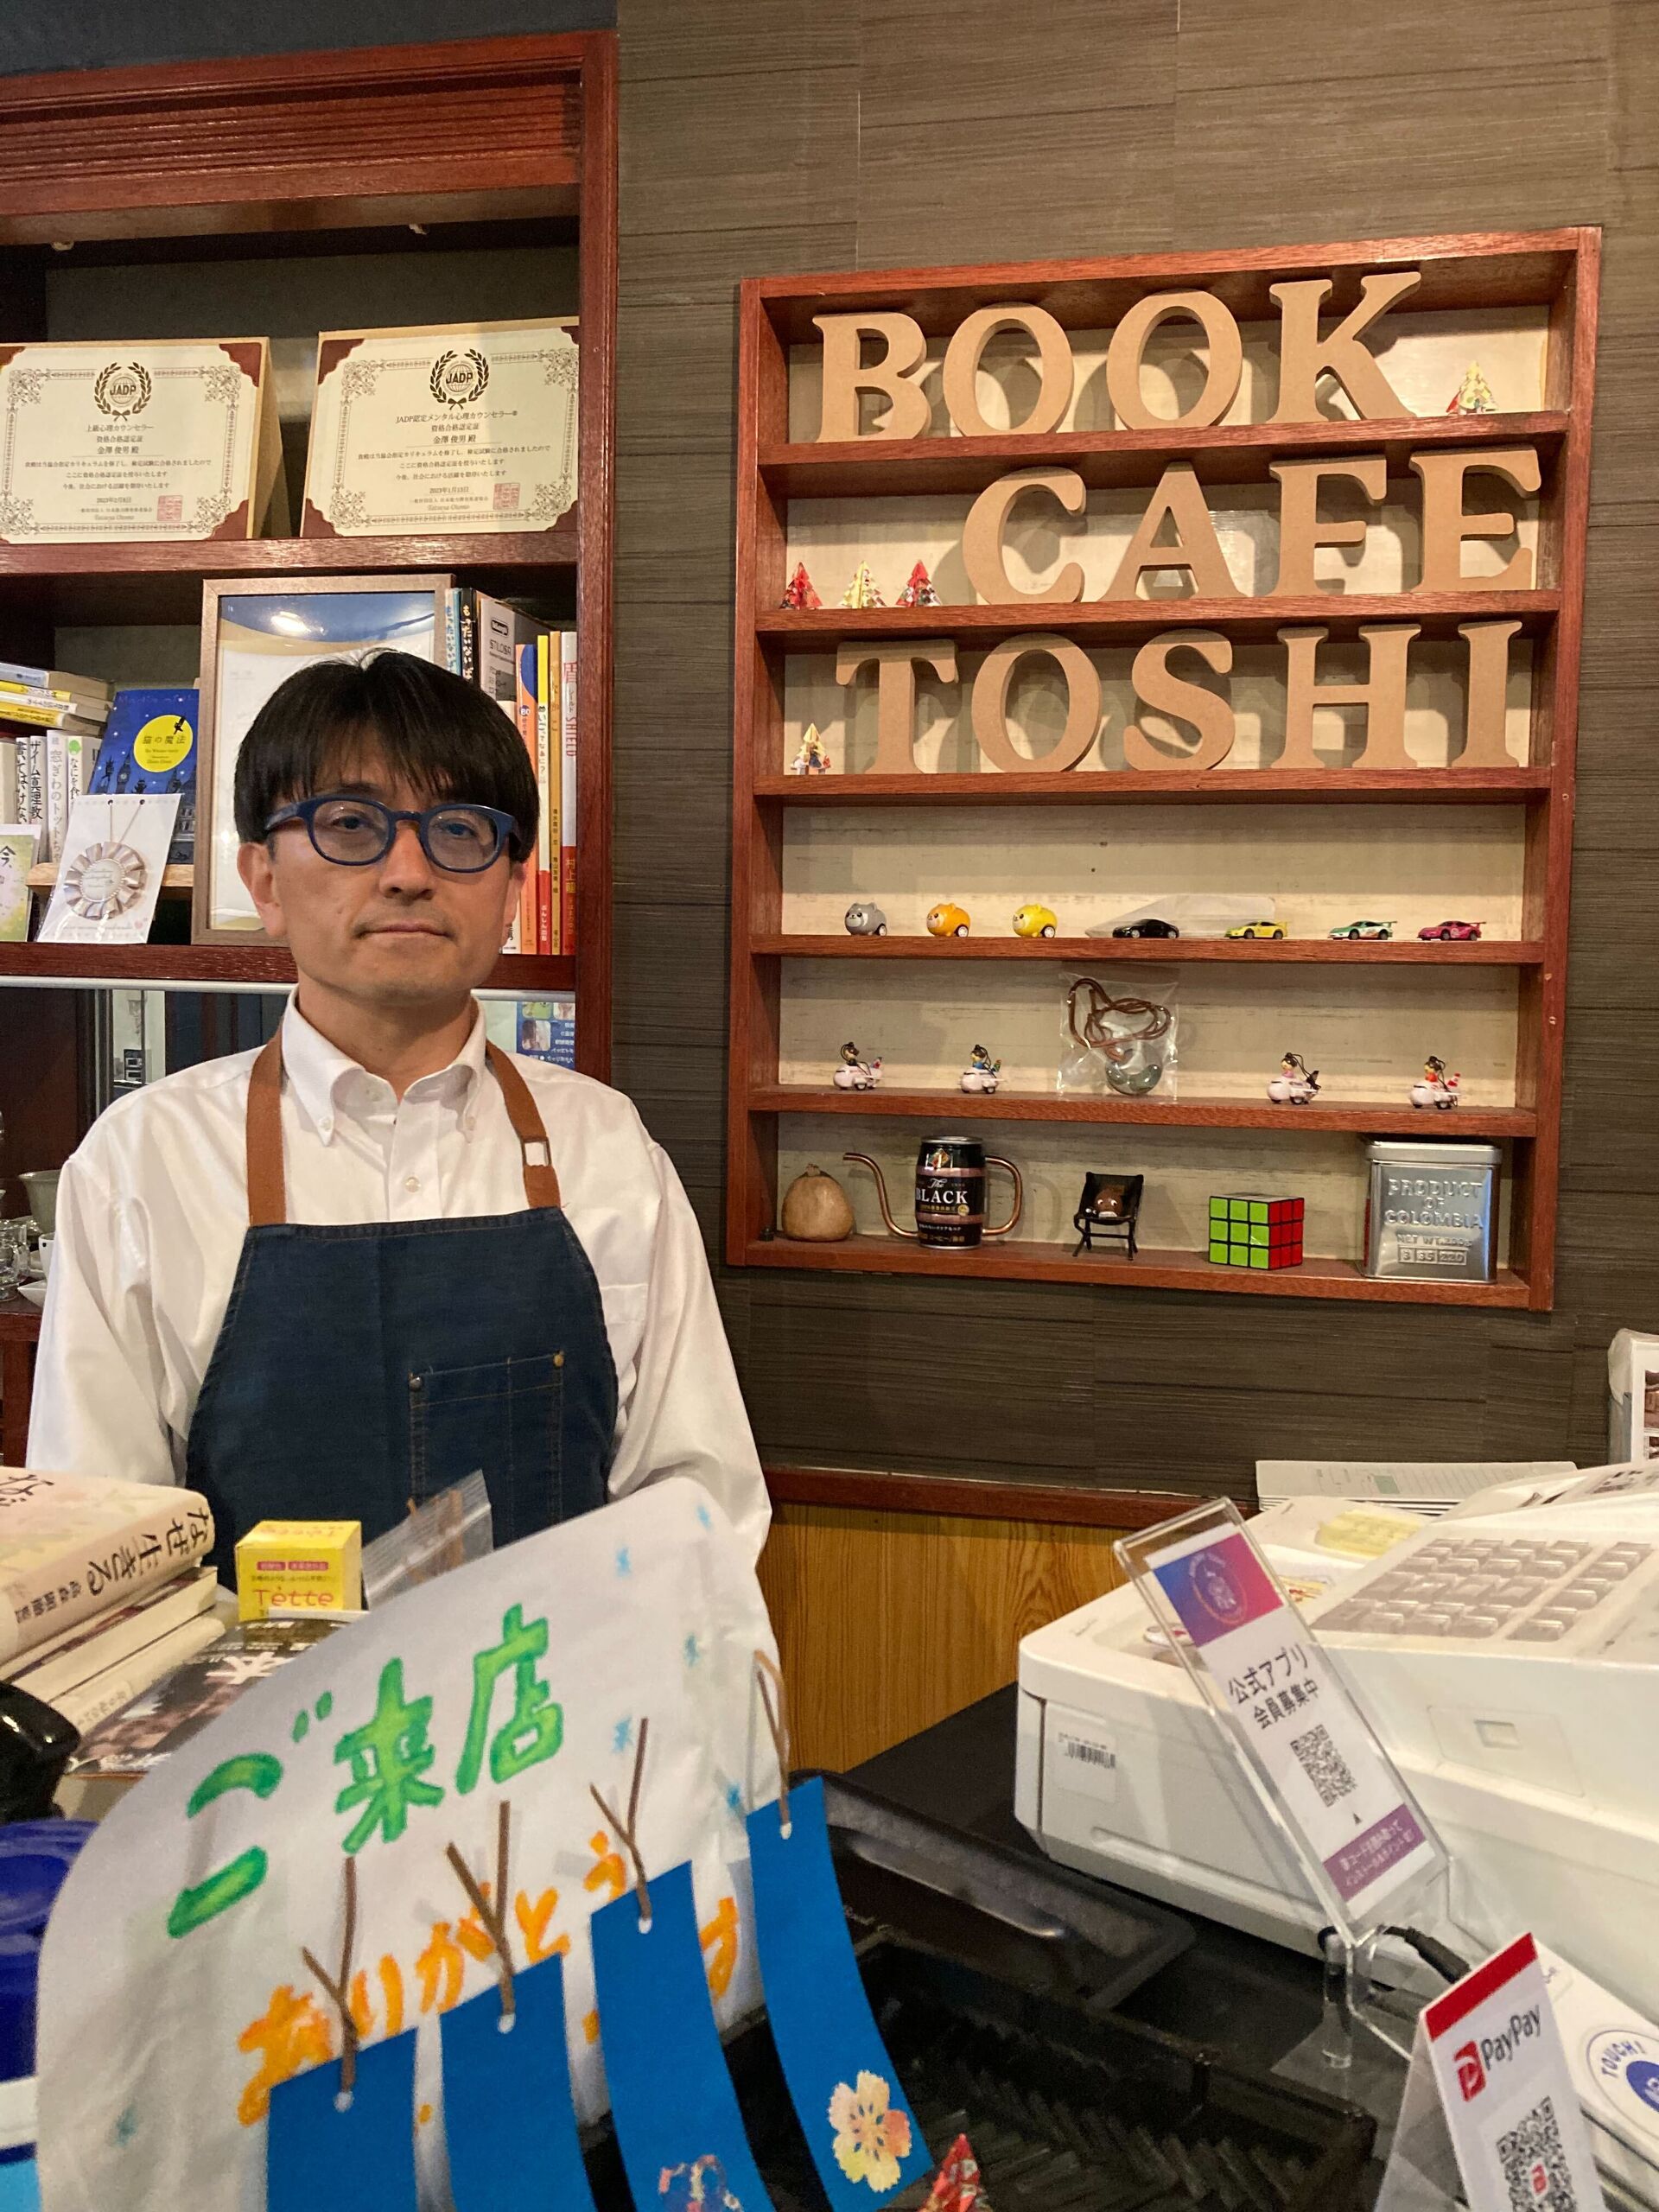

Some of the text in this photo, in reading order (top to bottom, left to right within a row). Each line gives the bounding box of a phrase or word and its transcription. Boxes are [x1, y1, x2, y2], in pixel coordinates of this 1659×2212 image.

[812, 270, 1423, 443] BOOK
[109, 384, 137, 397] JADP
[446, 372, 474, 385] JADP
[962, 444, 1543, 606] CAFE
[835, 619, 1524, 774] TOSHI
[565, 716, 577, 757] SHIELD
[916, 1187, 969, 1205] BLACK
[1388, 1178, 1484, 1198] PRODUCT
[1424, 1196, 1446, 1210] OF
[1383, 1210, 1484, 1230] COLOMBIA
[1396, 1234, 1418, 1244] NET
[1227, 1642, 1309, 1706] 公式アプリ
[1253, 1679, 1319, 1731] 会員募集中
[167, 1603, 565, 1939] ご来店
[1480, 2003, 1541, 2071] PayPay
